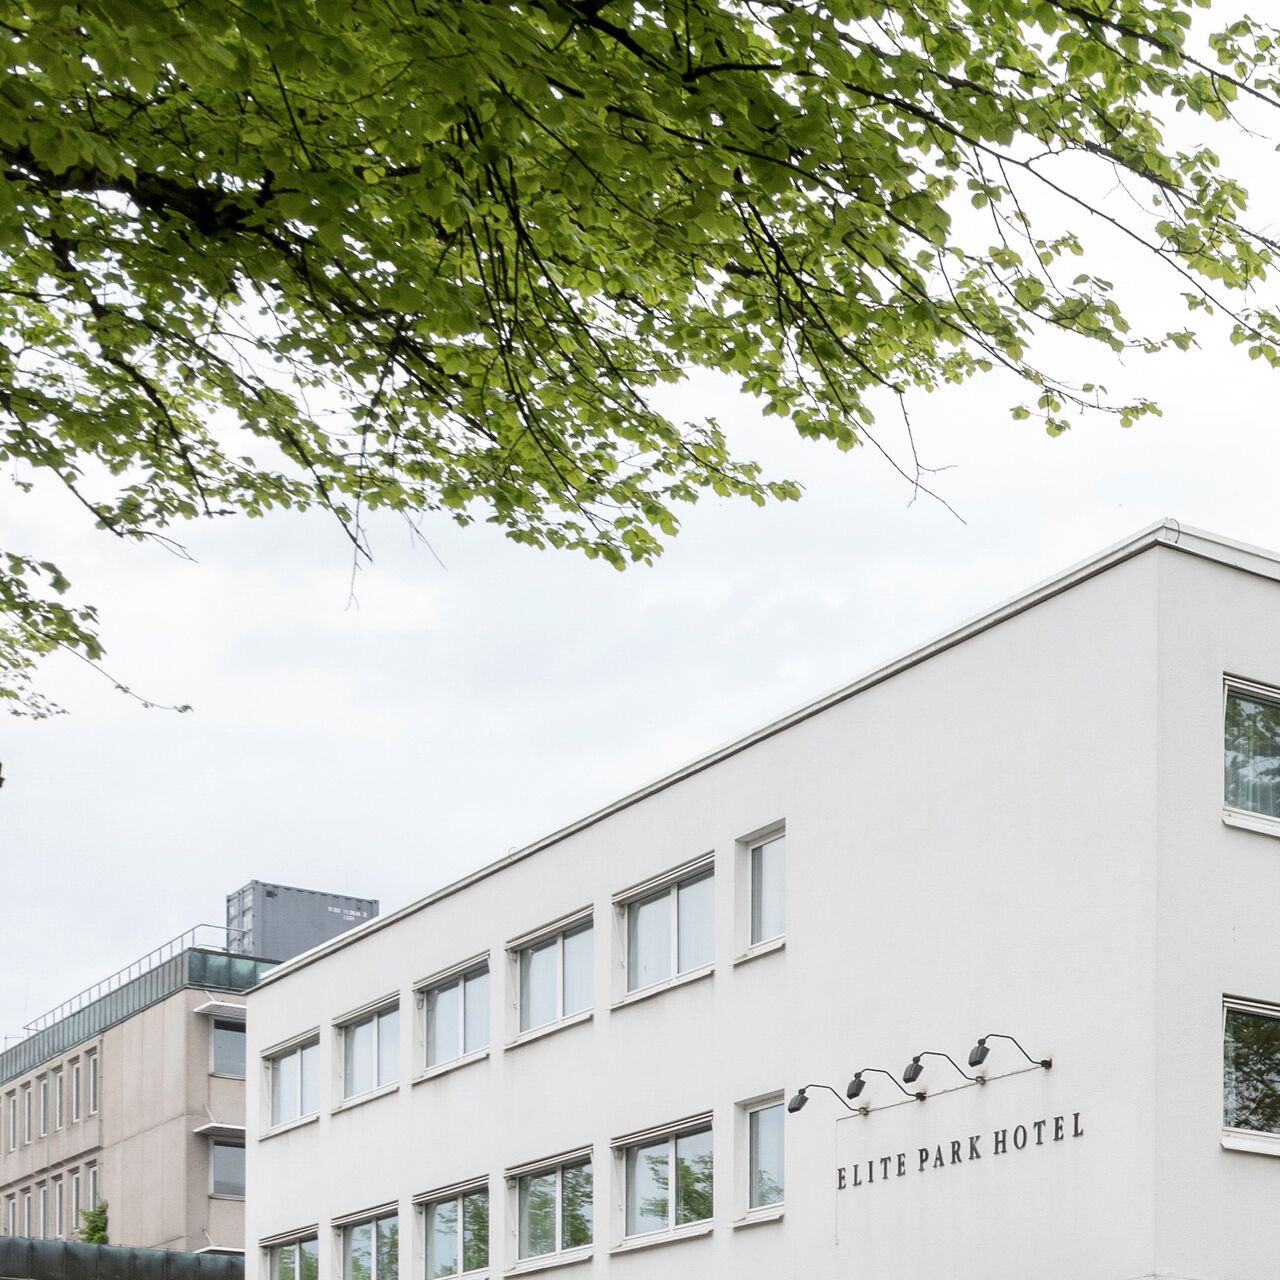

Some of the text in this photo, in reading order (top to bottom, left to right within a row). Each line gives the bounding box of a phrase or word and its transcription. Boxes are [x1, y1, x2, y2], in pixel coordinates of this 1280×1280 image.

[836, 1112, 1084, 1190] ELITE PARK HOTEL
